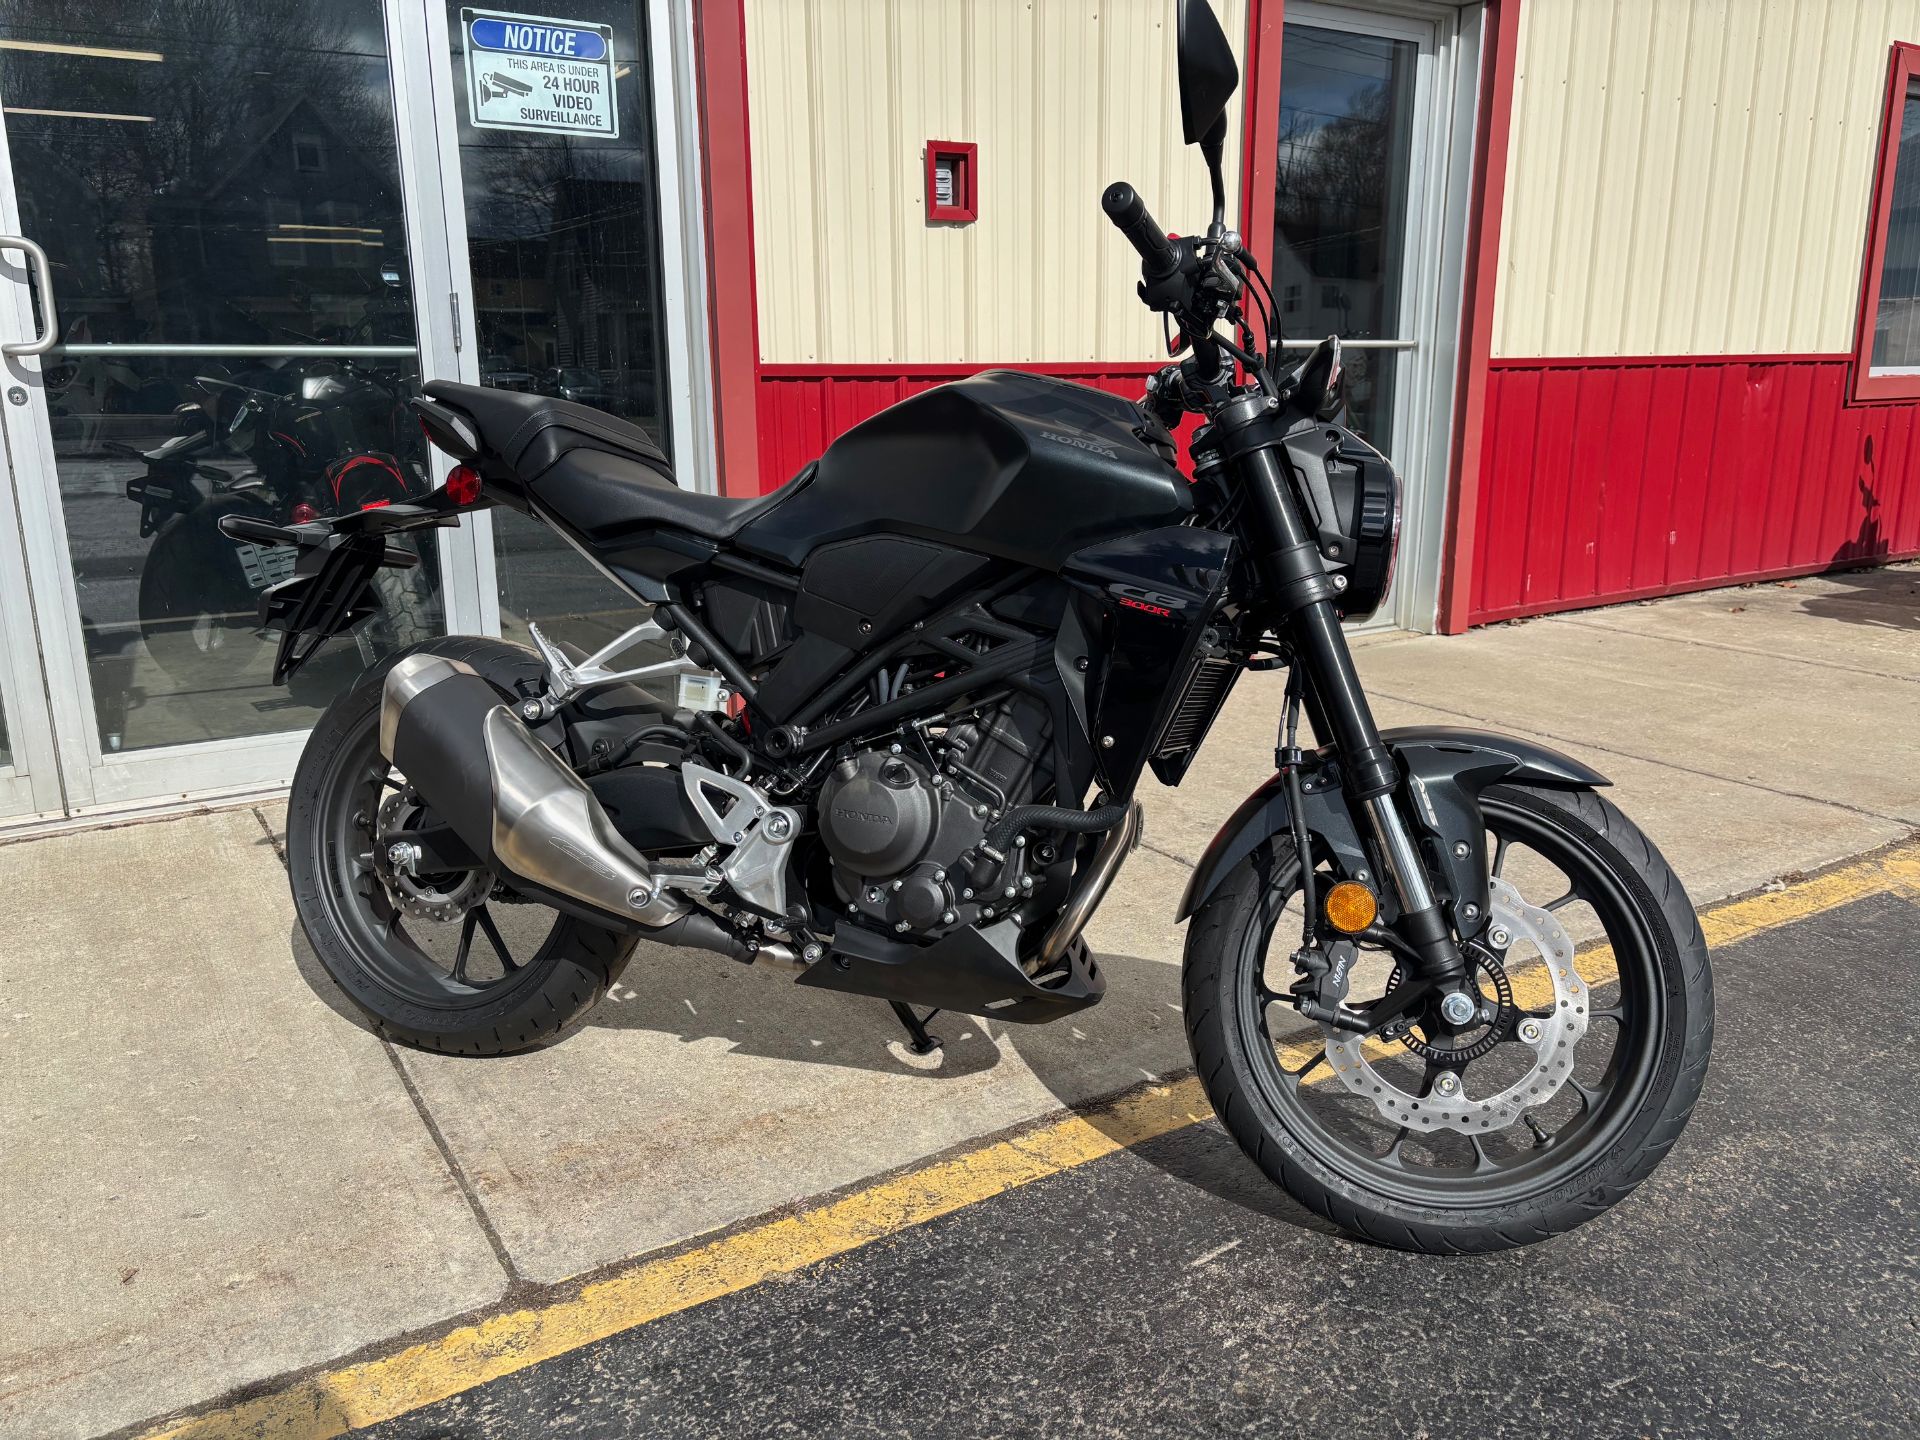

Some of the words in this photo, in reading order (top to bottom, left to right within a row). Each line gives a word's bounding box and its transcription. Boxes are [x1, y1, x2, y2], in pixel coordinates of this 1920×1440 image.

[504, 24, 577, 55] NOTICE
[507, 57, 529, 70] THIS
[530, 60, 554, 73] AREA
[557, 63, 566, 74] IS
[568, 65, 599, 78] UNDER
[542, 75, 560, 91] 24
[563, 78, 600, 94] HOUR
[553, 94, 593, 111] VIDEO
[520, 107, 603, 126] SURVEILLANCE
[1040, 431, 1118, 460] HONDA
[1109, 583, 1188, 609] CB
[1119, 597, 1171, 617] 300R
[835, 808, 893, 825] HONDA
